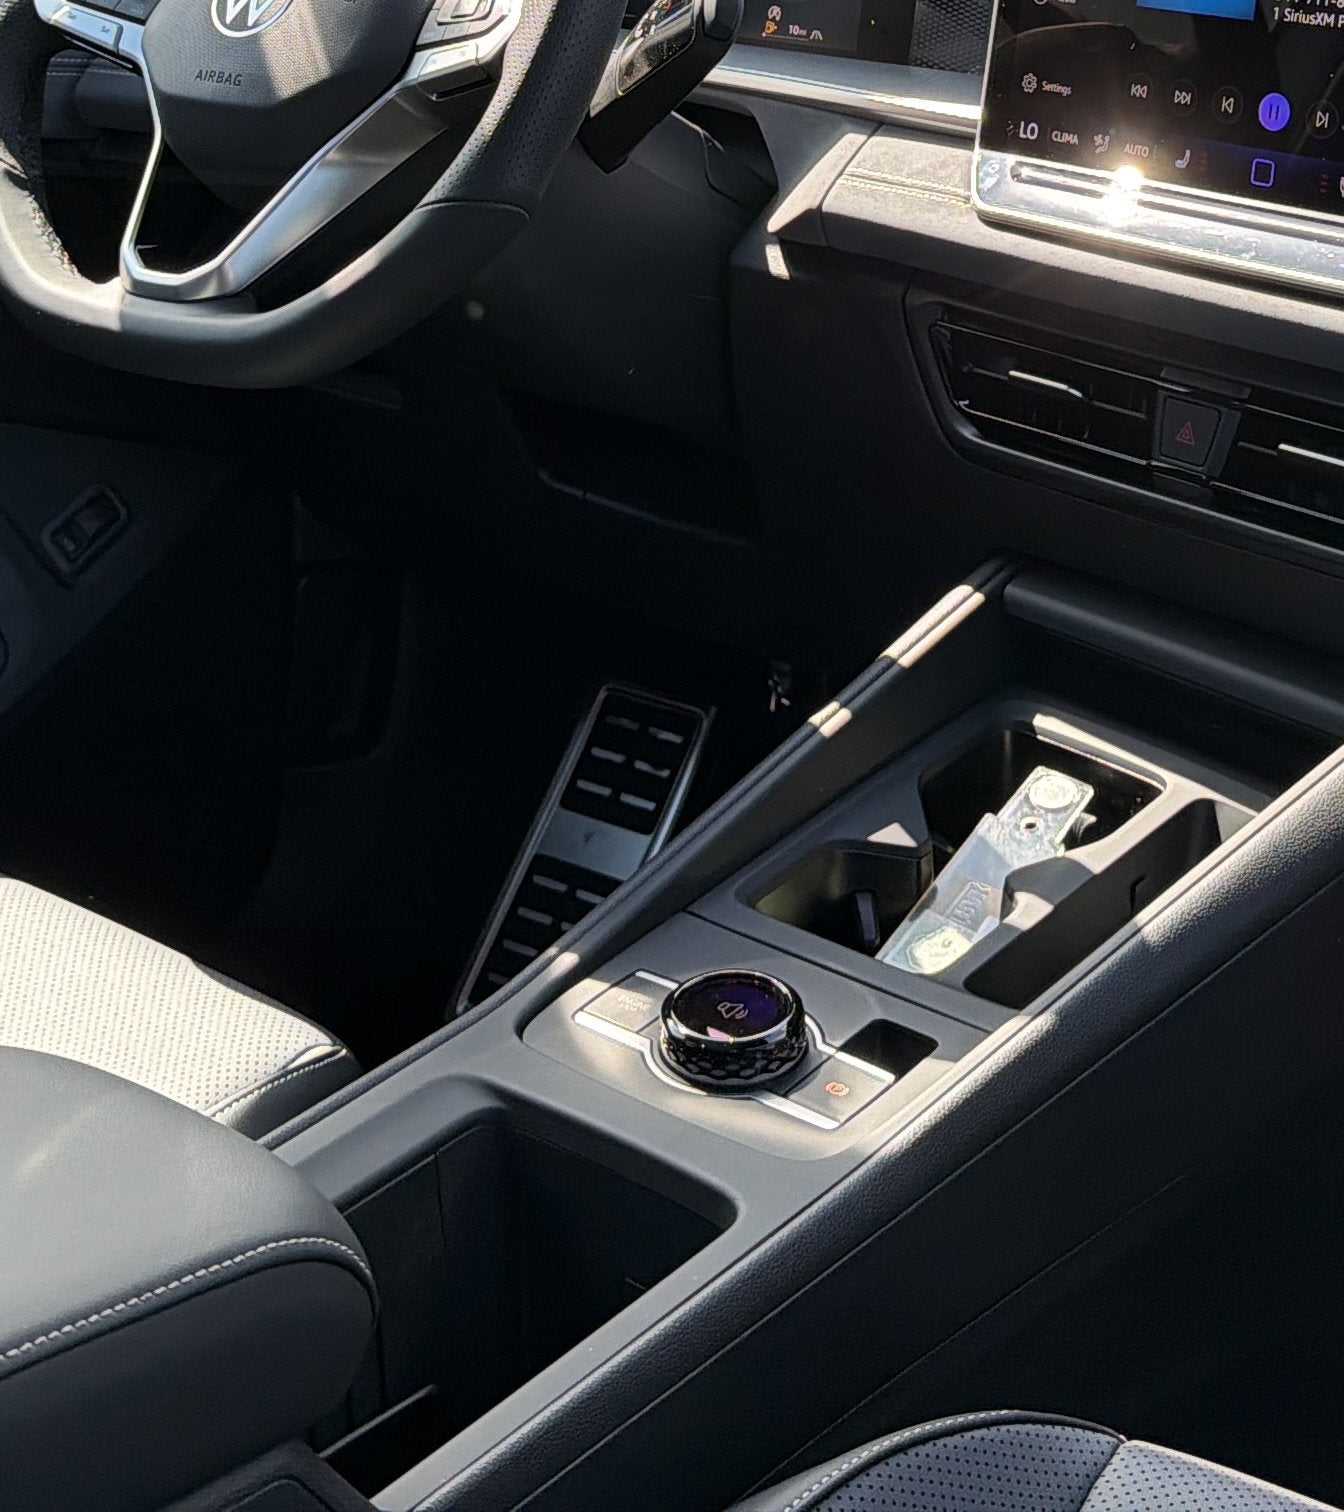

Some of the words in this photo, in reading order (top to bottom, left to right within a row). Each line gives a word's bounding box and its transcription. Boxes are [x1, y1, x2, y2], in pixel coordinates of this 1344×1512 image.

[1283, 8, 1335, 29] SiriusXM
[194, 67, 243, 88] AIRBAG
[1041, 80, 1072, 97] Settings
[1018, 120, 1039, 140] LO
[1051, 130, 1079, 146] CLIMA
[1123, 143, 1150, 158] AUTO
